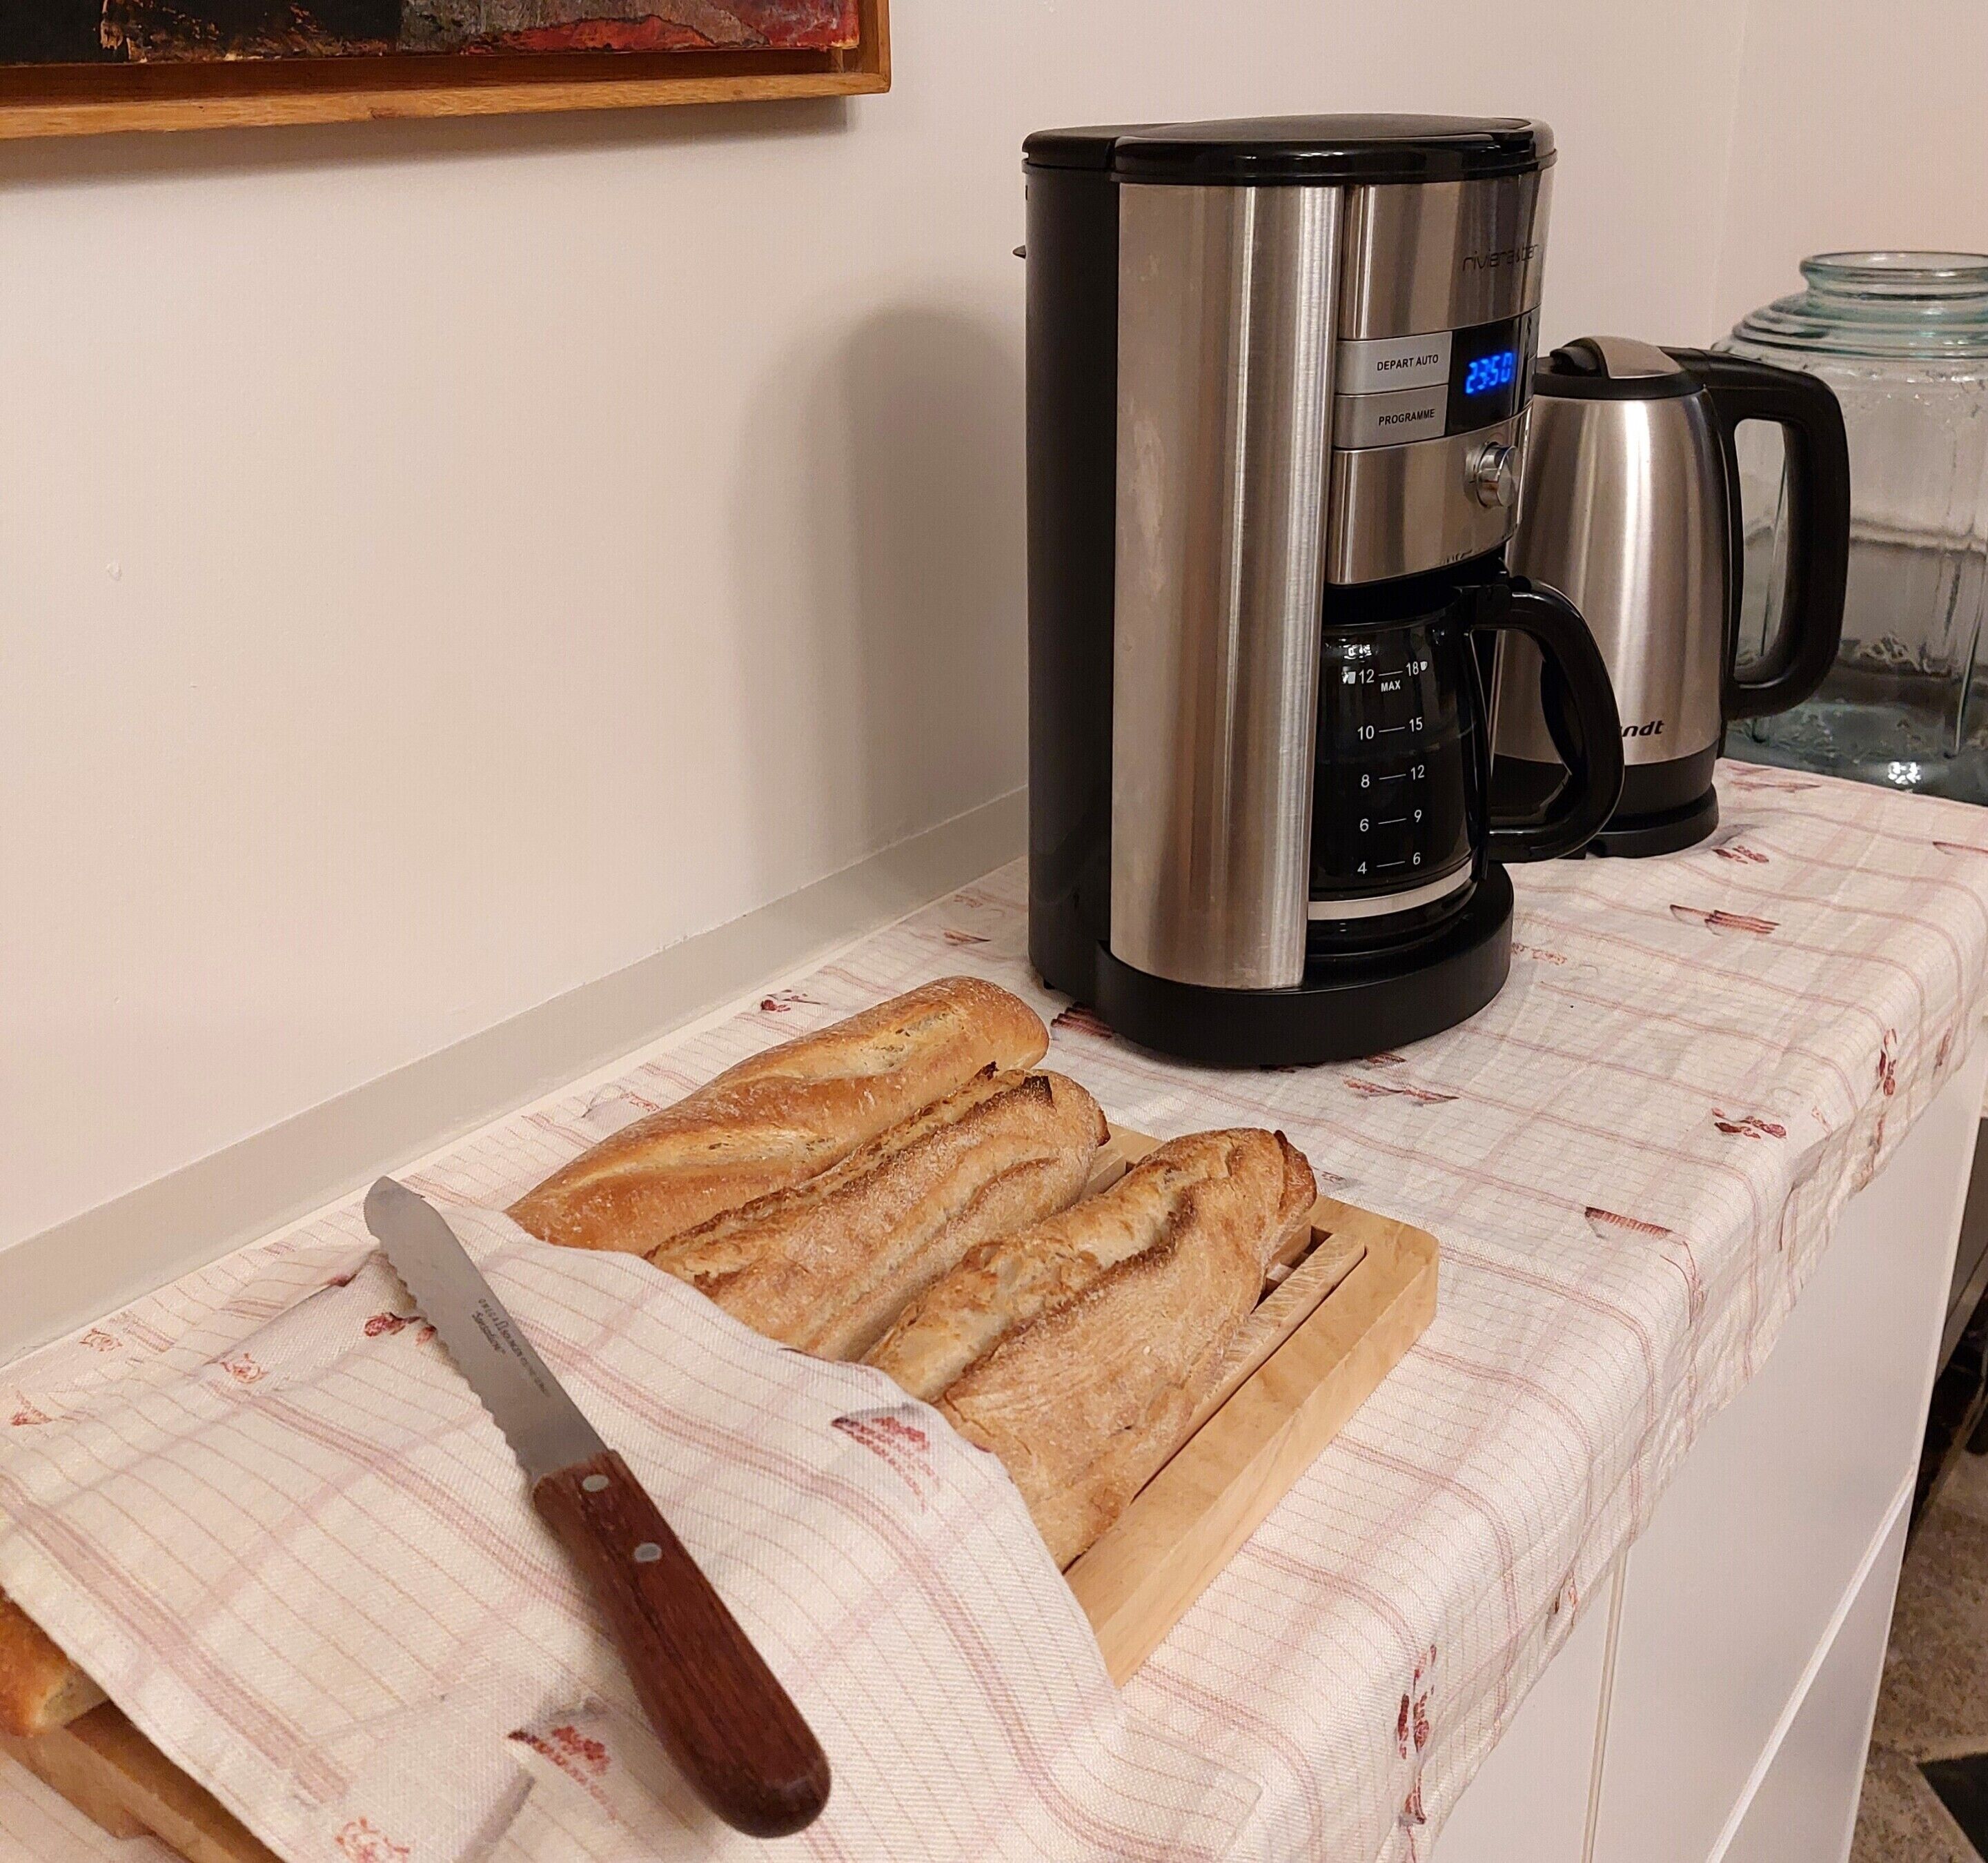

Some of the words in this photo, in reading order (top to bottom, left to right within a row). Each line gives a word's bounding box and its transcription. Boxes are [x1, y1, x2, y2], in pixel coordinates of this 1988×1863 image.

[1377, 357, 1414, 371] DEPART
[1415, 354, 1439, 366] AUTO
[1378, 408, 1436, 426] PROGRAMME
[1358, 669, 1375, 684] 12
[1406, 661, 1419, 676] 18
[1381, 680, 1401, 692] MAX
[1357, 725, 1375, 740] 10
[1409, 716, 1423, 732] 15
[1620, 720, 1664, 738] ndt
[1361, 773, 1370, 788] 8
[1410, 765, 1425, 780] 12
[1359, 818, 1369, 832] 6
[1414, 809, 1422, 823] 9
[1357, 861, 1368, 875] 4
[1413, 852, 1421, 865] 6
